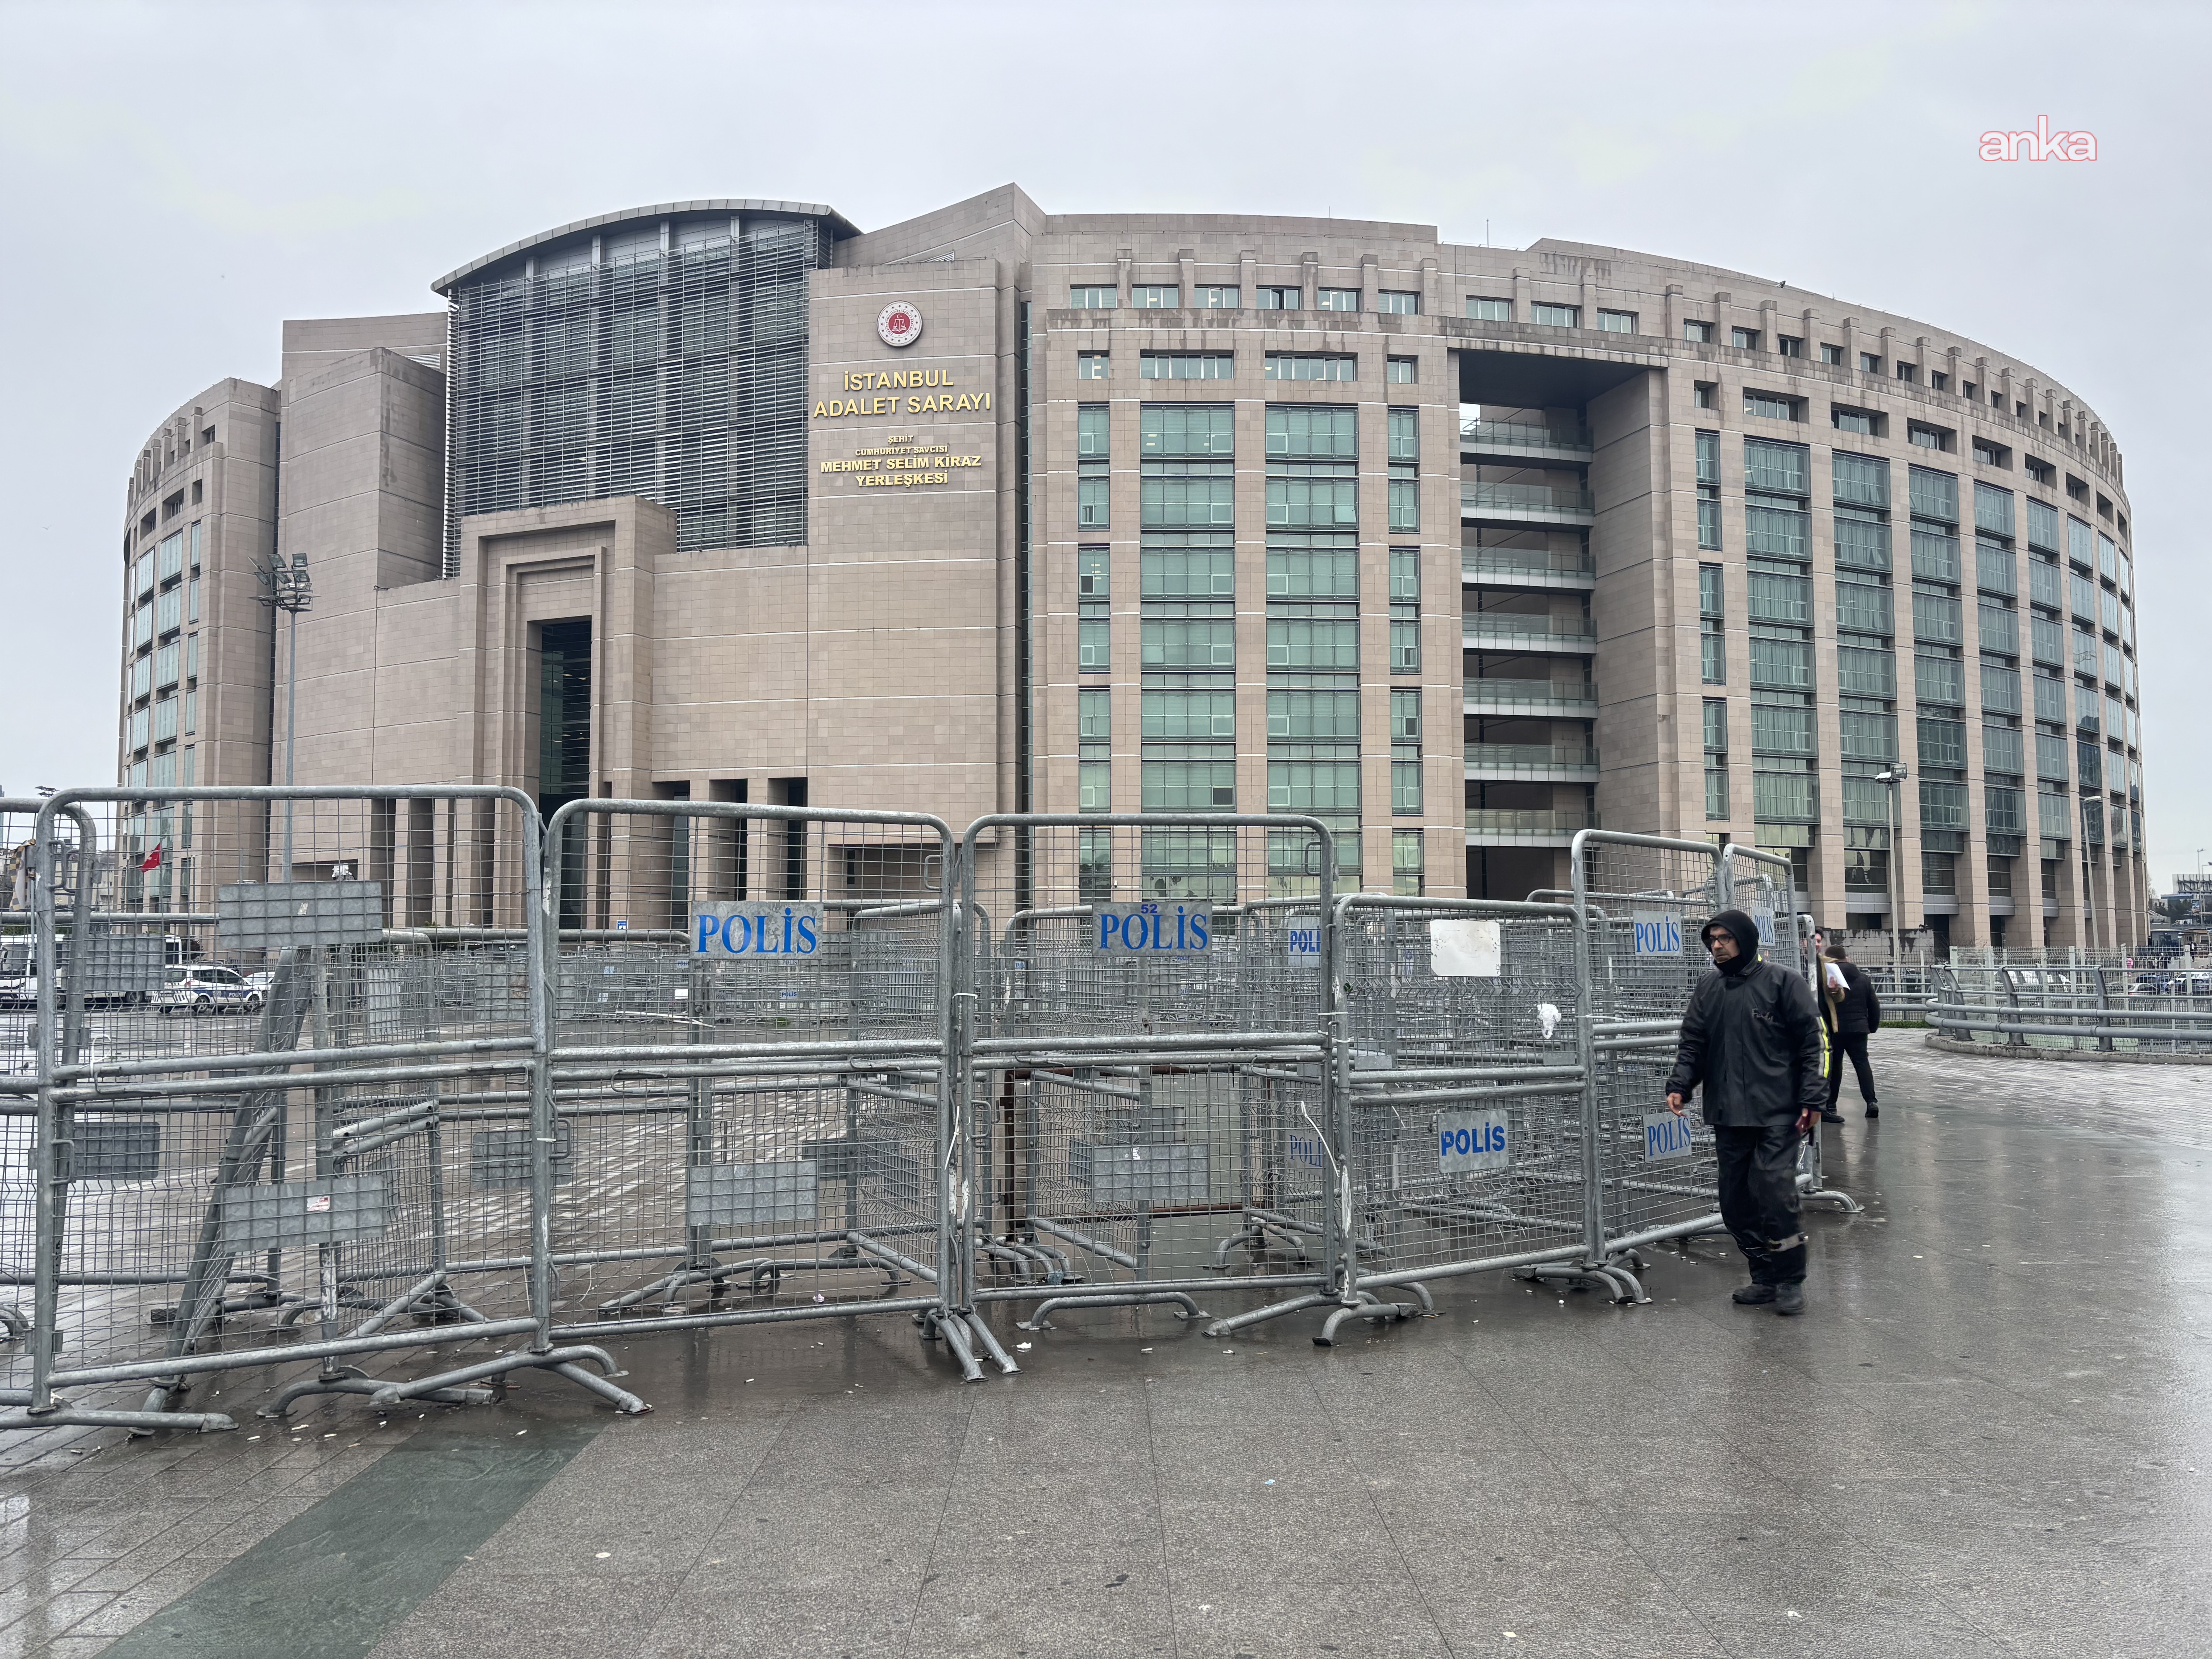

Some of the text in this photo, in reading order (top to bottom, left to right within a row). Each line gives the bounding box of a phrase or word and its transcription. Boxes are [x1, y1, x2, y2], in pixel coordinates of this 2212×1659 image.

[845, 369, 954, 391] İSTANBUL
[813, 392, 990, 418] ADALET SARAYI
[855, 445, 948, 456] CUMHURİYET SAVCISI
[888, 434, 914, 444] ŞEHİT
[821, 453, 982, 473] MEHMET SELİM KİRAZ
[855, 470, 948, 487] YERLEŞKESİ
[1140, 903, 1158, 914] 52
[695, 907, 817, 954] POLİS
[1097, 905, 1208, 950] POLİS
[1290, 925, 1321, 952] POLİ
[1634, 915, 1680, 953] POLİS
[1289, 1135, 1322, 1167] POLİ
[1441, 1122, 1505, 1156] POLİS
